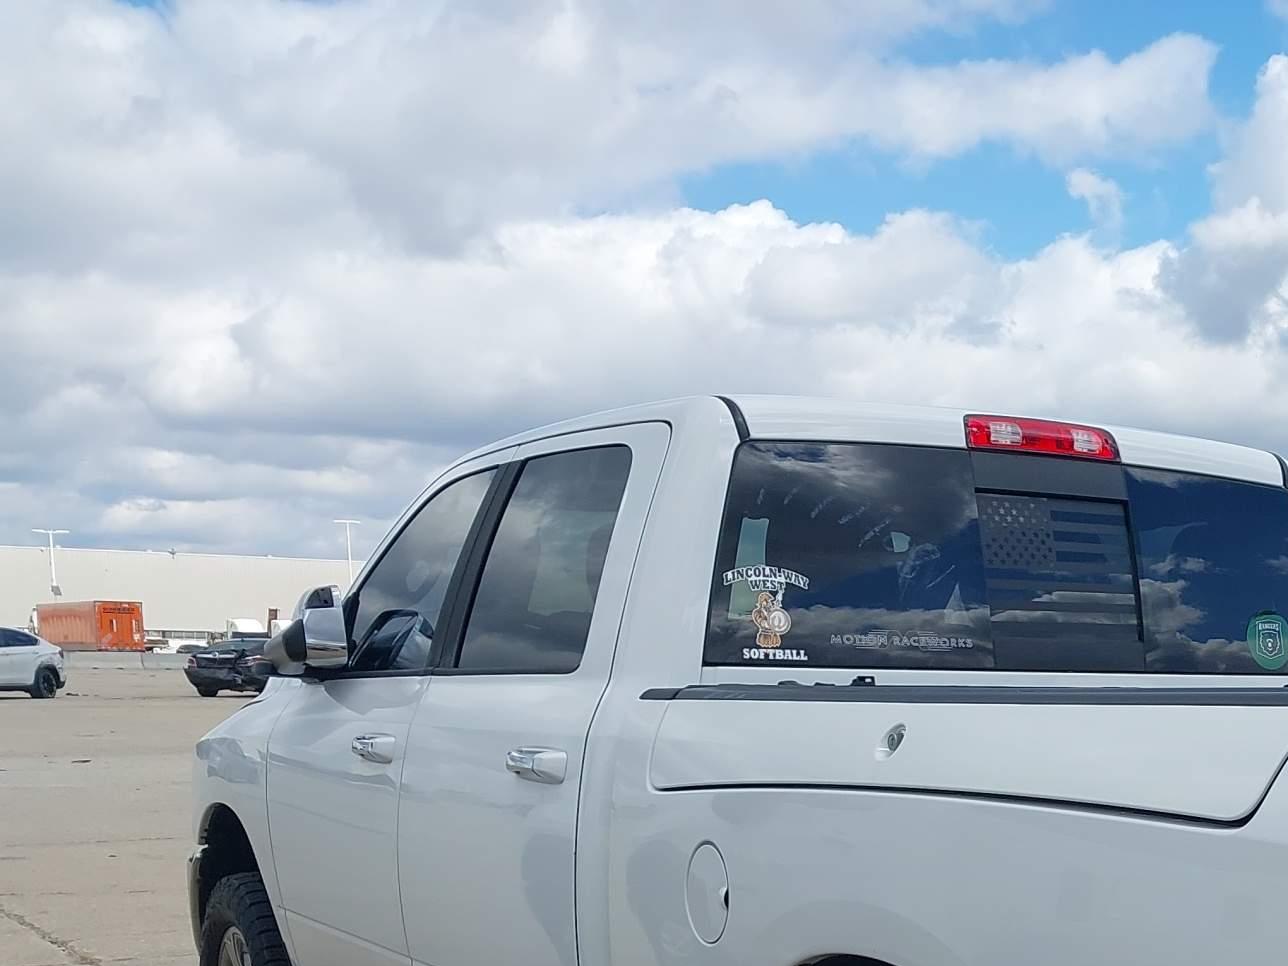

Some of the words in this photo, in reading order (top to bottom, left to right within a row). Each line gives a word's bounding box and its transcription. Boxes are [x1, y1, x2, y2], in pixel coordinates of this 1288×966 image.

[723, 565, 809, 589] LINCOLN-WAY
[749, 579, 785, 591] WEST
[742, 648, 808, 660] SOFTBALL
